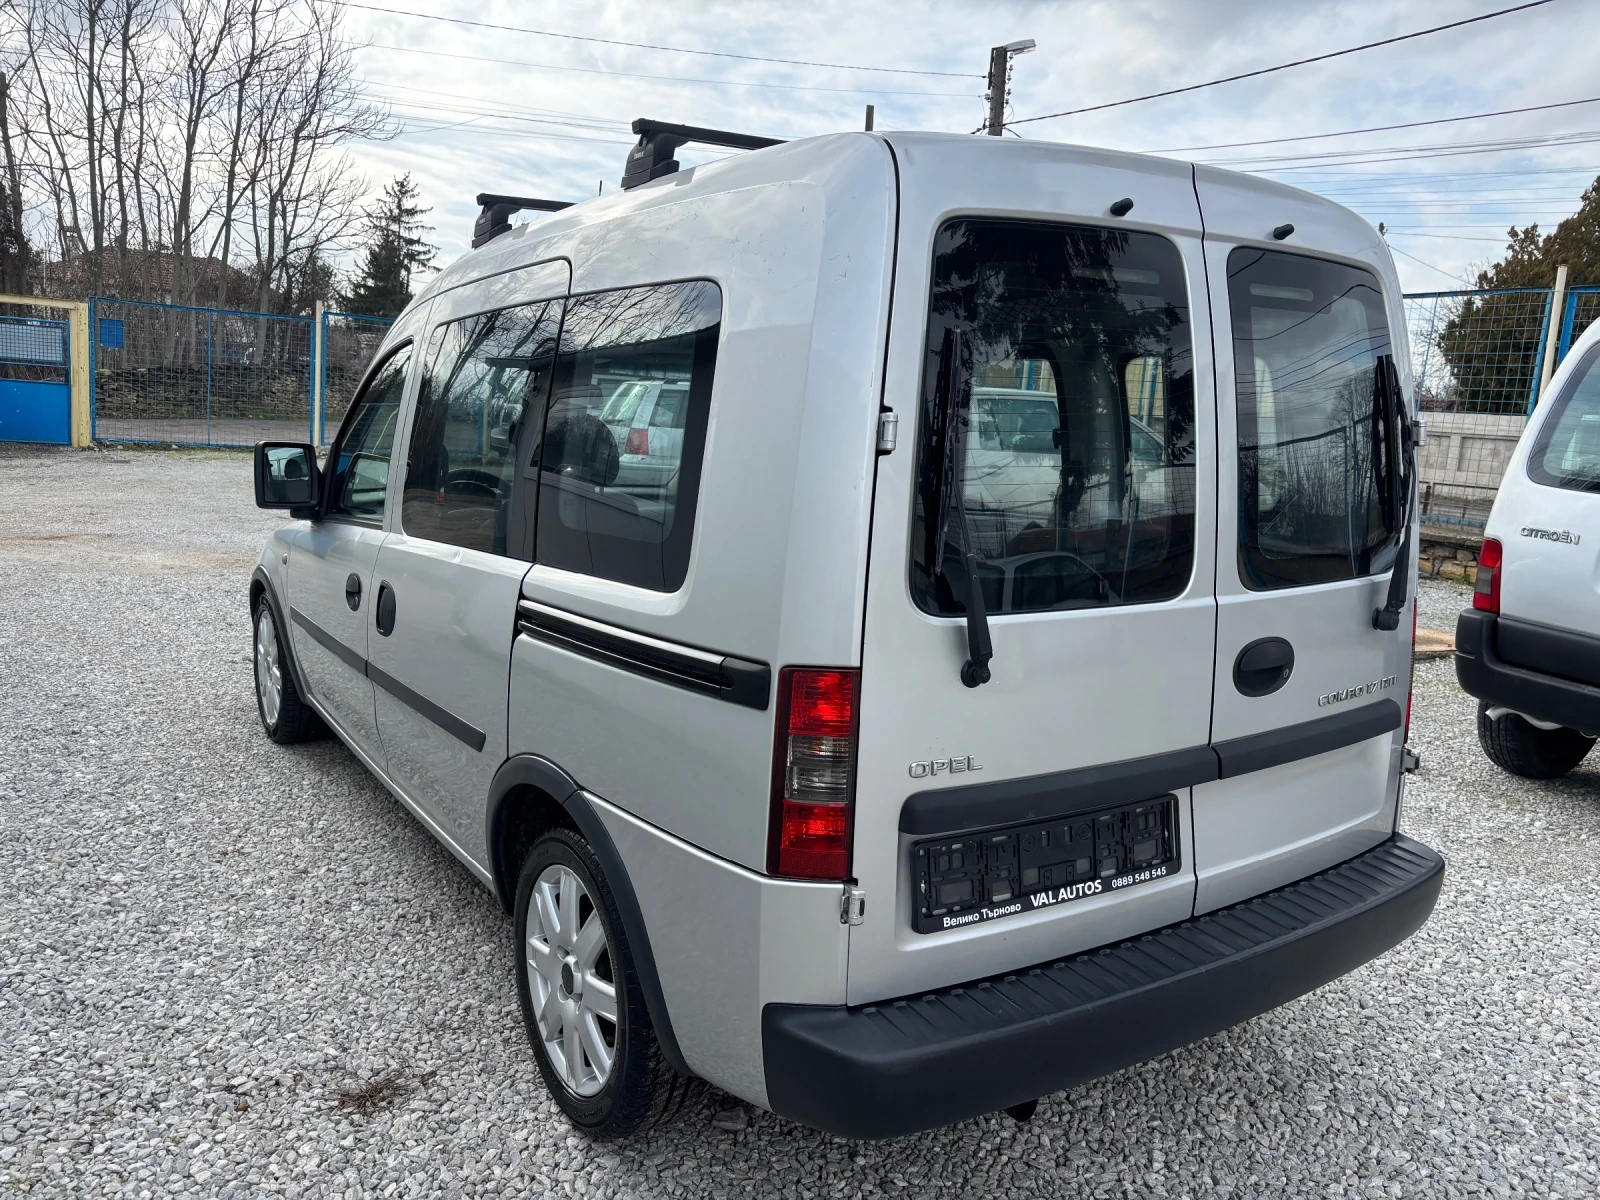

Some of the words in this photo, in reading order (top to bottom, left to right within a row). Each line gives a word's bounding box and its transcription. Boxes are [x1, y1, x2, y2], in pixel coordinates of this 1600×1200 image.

[1520, 526, 1581, 546] CITROËN
[1318, 685, 1364, 707] COMBO
[908, 754, 984, 779] OPEL
[1111, 875, 1133, 888] 0889
[1134, 870, 1150, 882] 548
[1151, 866, 1167, 878] 545
[943, 912, 980, 928] Велико
[981, 903, 1022, 920] Търново
